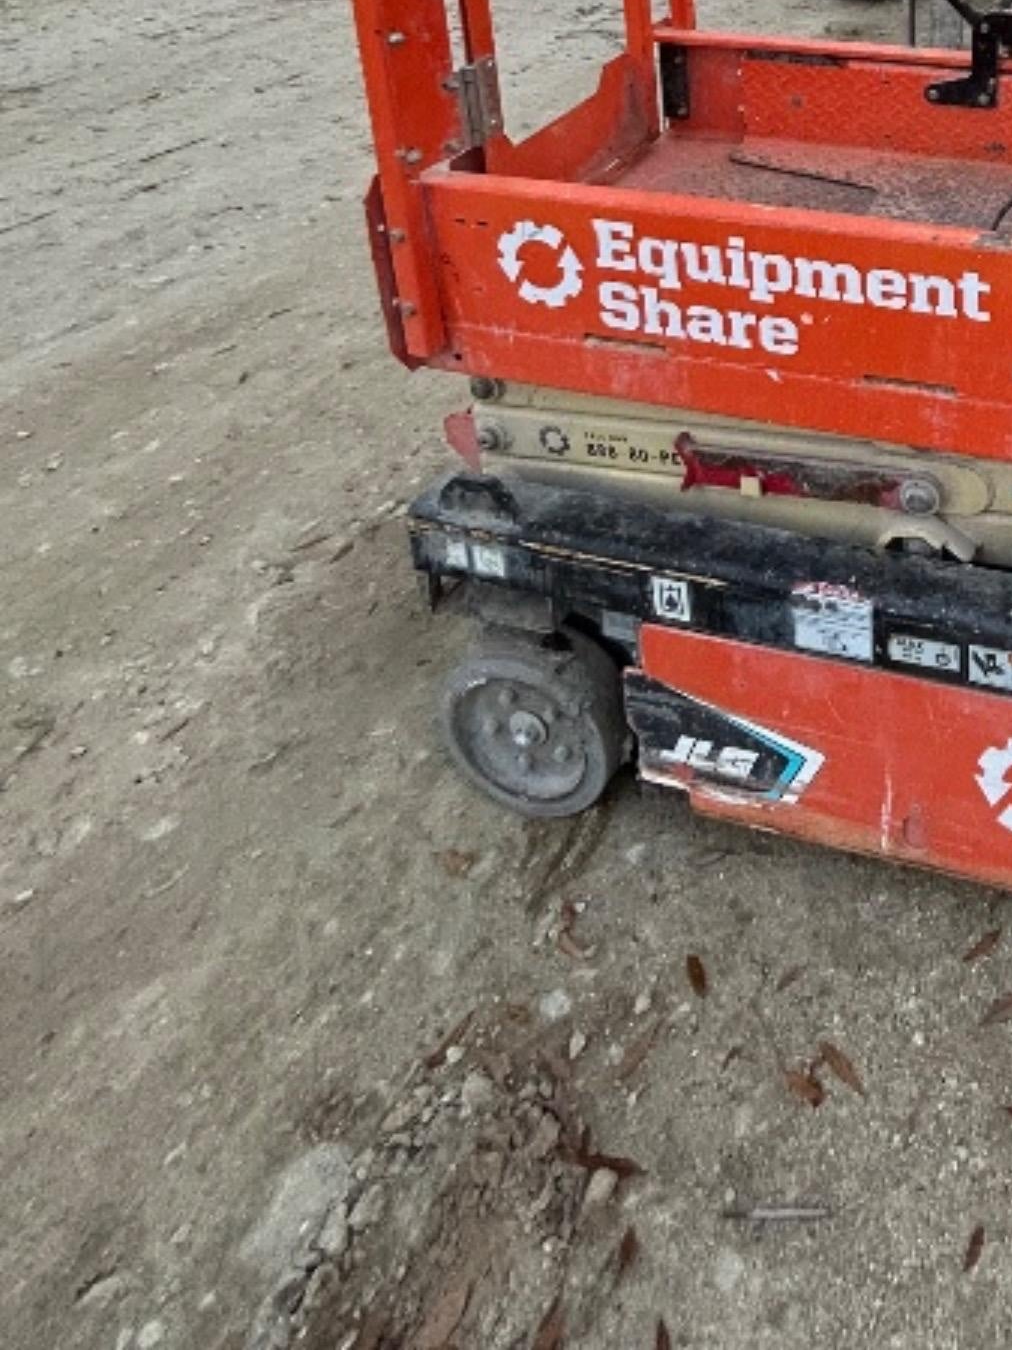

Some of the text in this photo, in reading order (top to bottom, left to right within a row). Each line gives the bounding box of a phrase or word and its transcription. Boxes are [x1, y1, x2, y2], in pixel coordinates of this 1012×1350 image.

[592, 217, 991, 323] Equipment
[598, 281, 799, 357] Share
[659, 733, 760, 779] JLG
